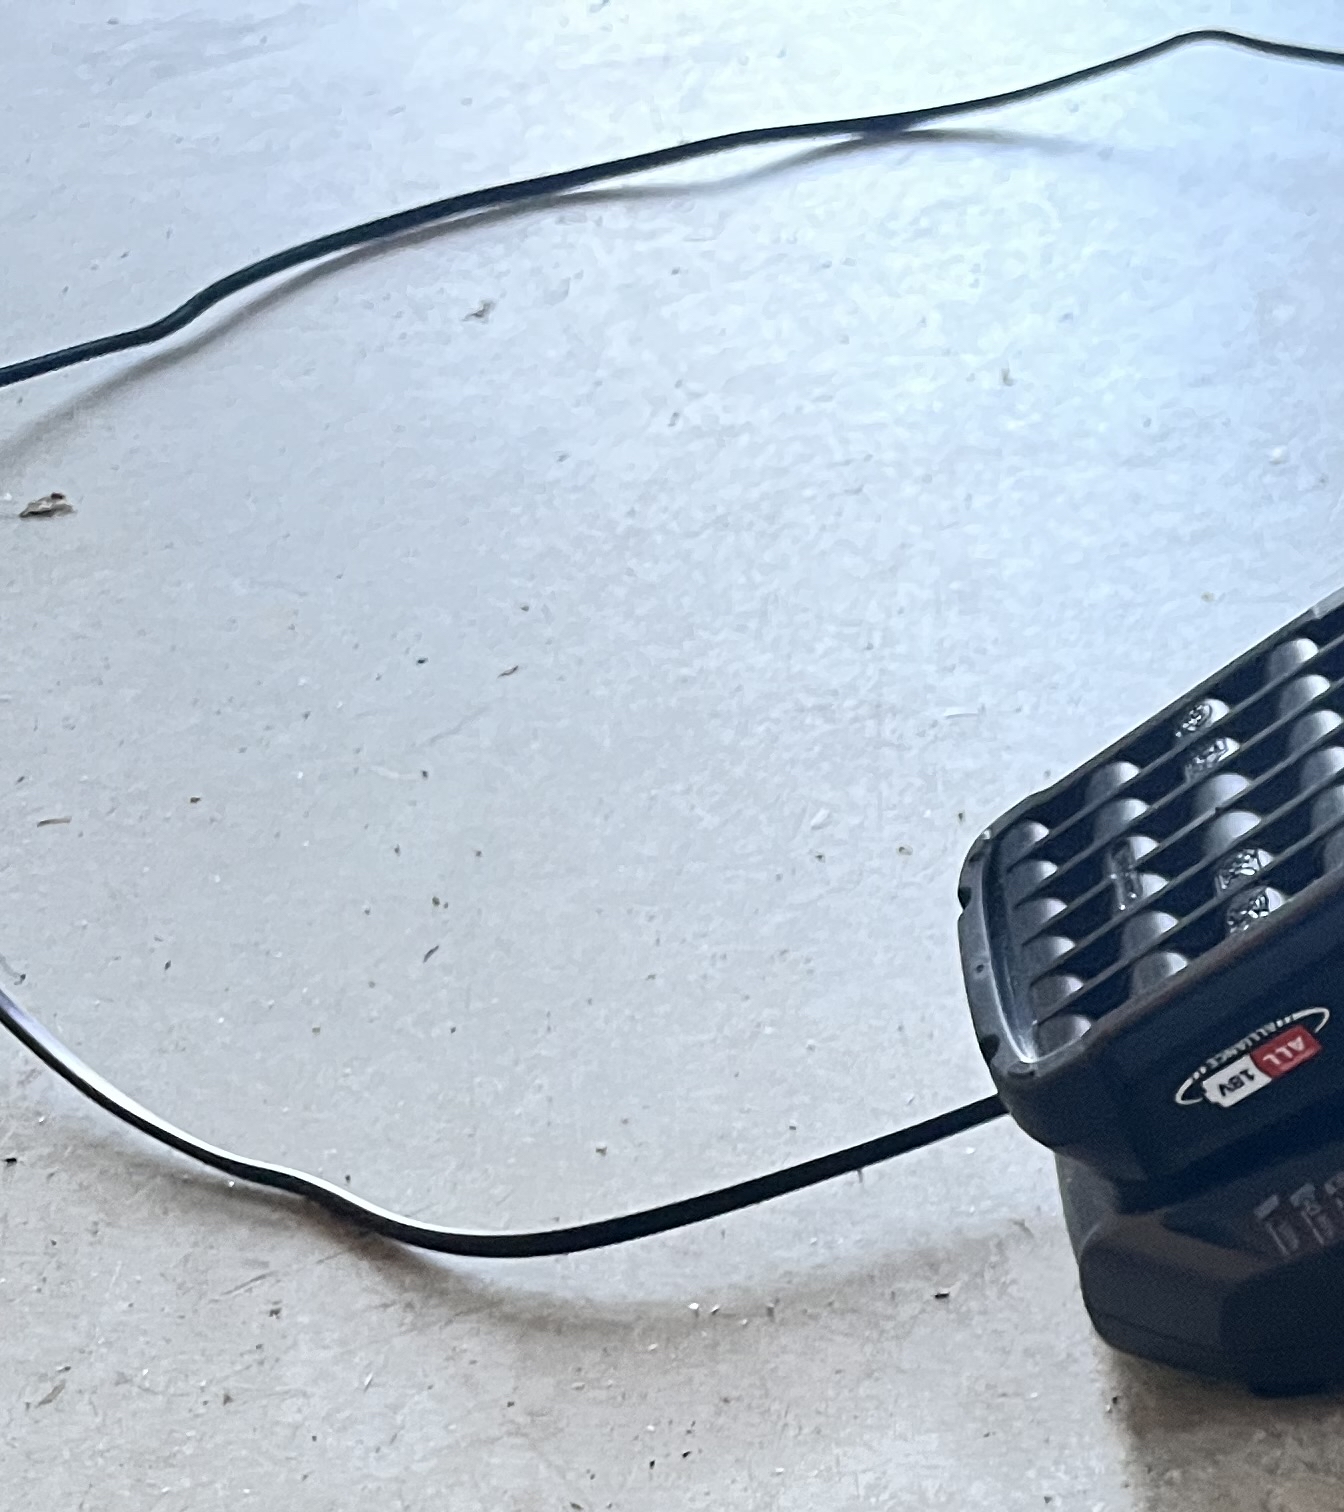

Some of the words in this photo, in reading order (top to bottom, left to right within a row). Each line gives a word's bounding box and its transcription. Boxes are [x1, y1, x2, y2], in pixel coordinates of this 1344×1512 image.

[1206, 1022, 1276, 1067] ALLIANCE
[1262, 1036, 1307, 1066] ALL
[1218, 1069, 1255, 1096] 18V
